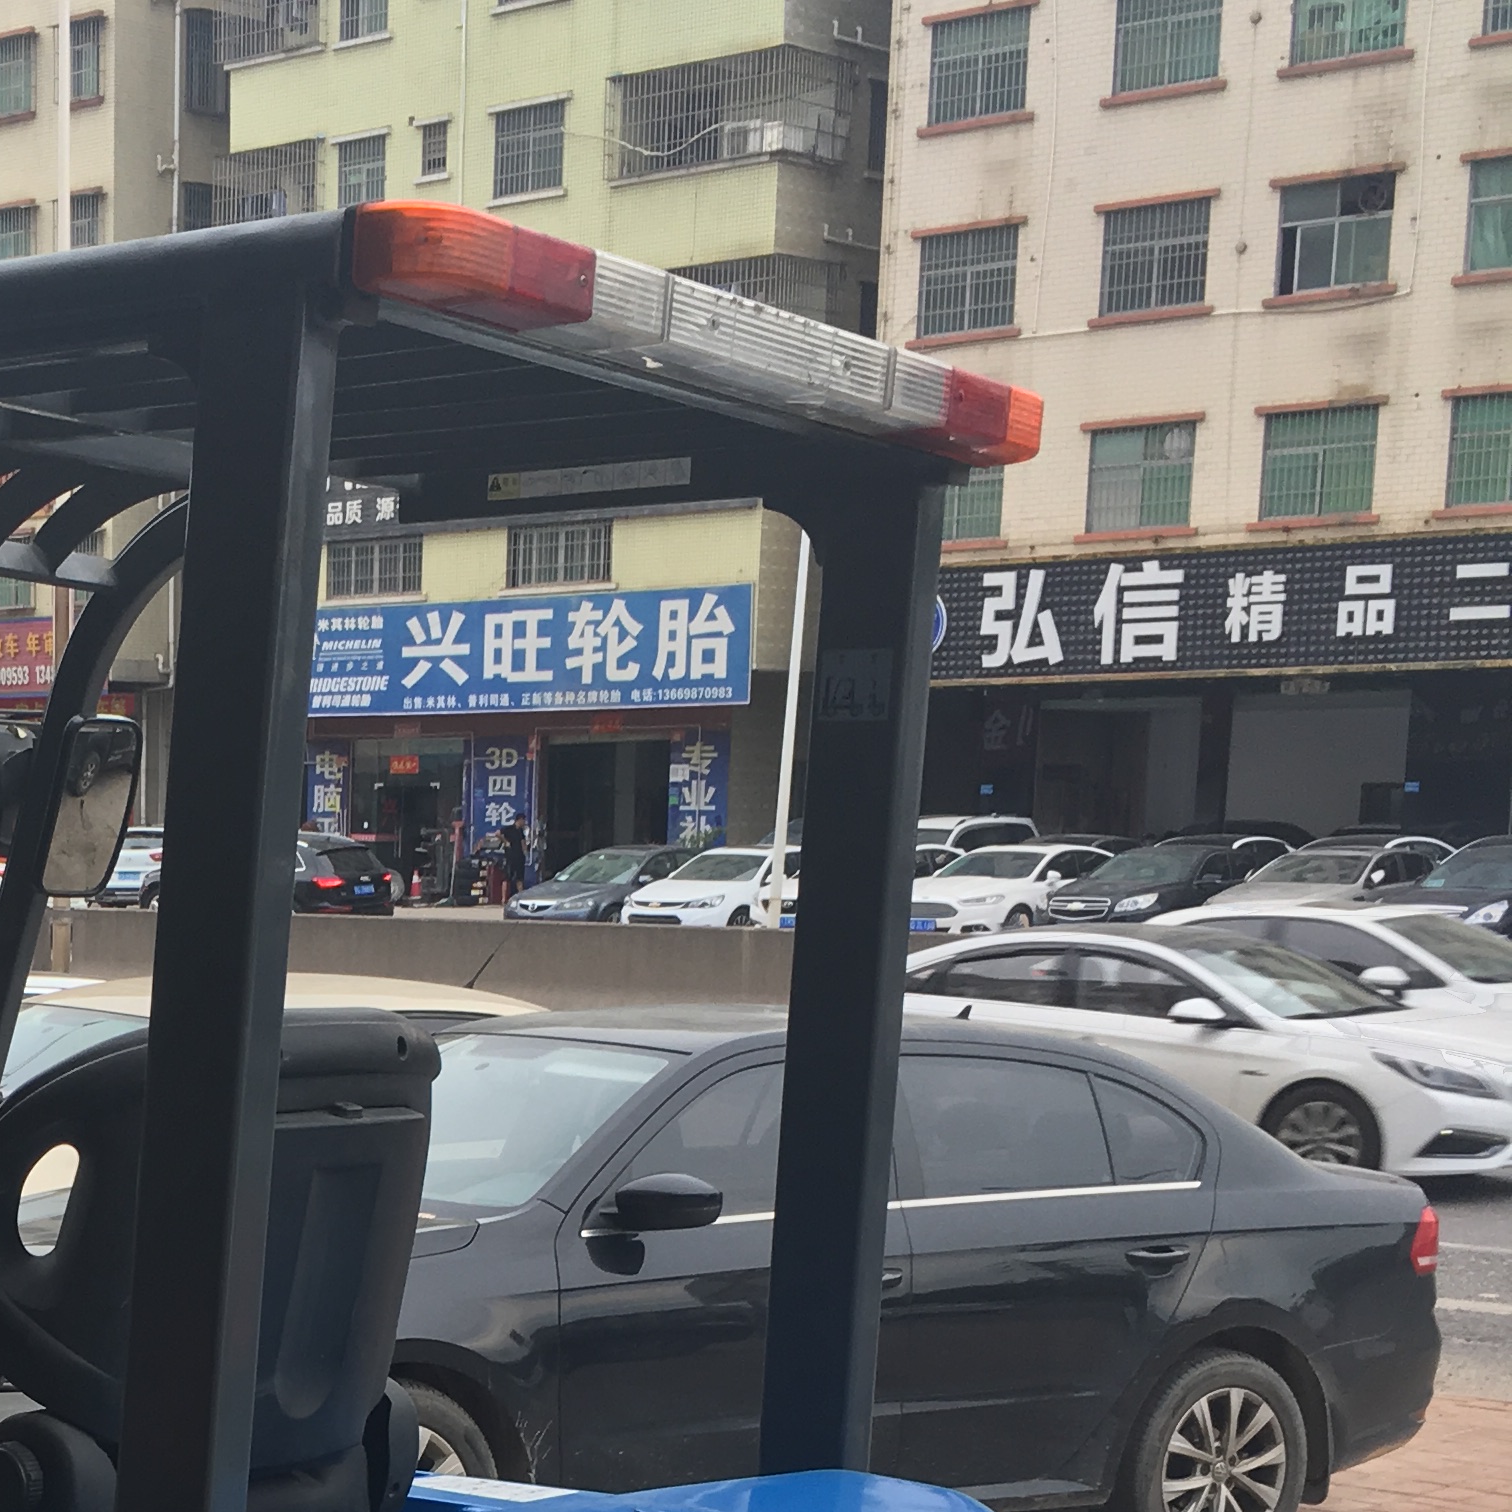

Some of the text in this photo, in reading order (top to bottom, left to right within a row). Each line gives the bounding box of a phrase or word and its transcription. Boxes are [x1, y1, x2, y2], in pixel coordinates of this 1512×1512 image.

[327, 500, 363, 525] 品质
[317, 616, 384, 632] 米其林轮胎
[321, 639, 383, 651] MICHELIN
[402, 593, 736, 689] 兴旺轮胎
[310, 676, 389, 693] RIDGESTONE
